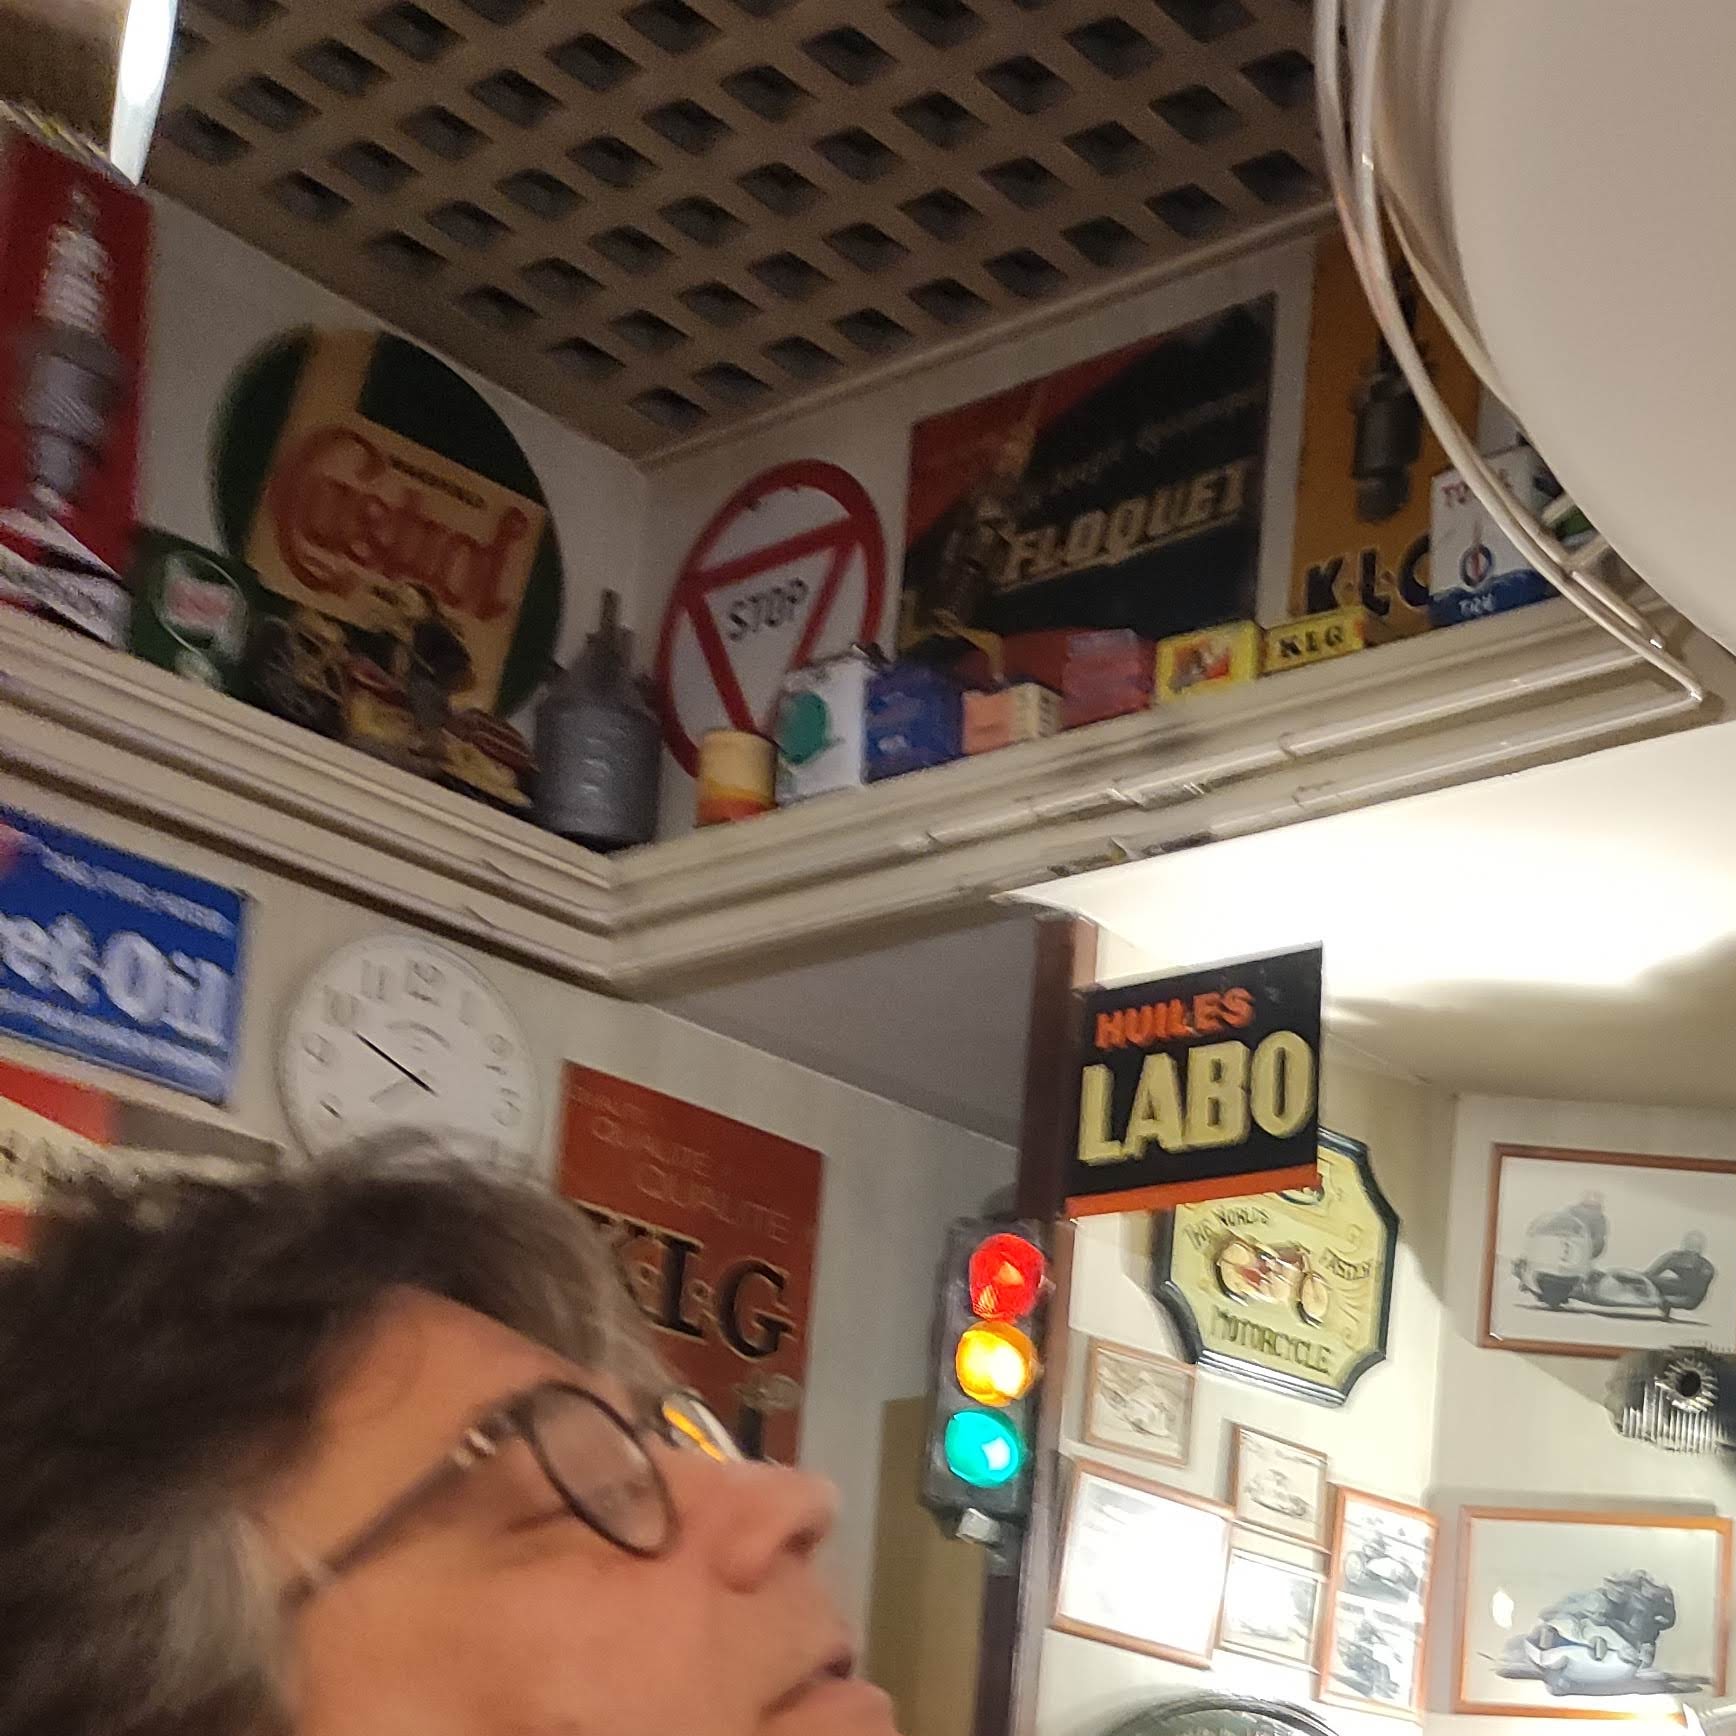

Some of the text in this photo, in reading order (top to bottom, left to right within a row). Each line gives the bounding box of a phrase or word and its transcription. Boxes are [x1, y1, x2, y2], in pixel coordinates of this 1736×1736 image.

[729, 577, 809, 641] STOP
[1096, 988, 1254, 1049] HUILES
[1078, 1031, 1314, 1166] LABO
[1210, 1304, 1332, 1377] MOTORCYCLE
